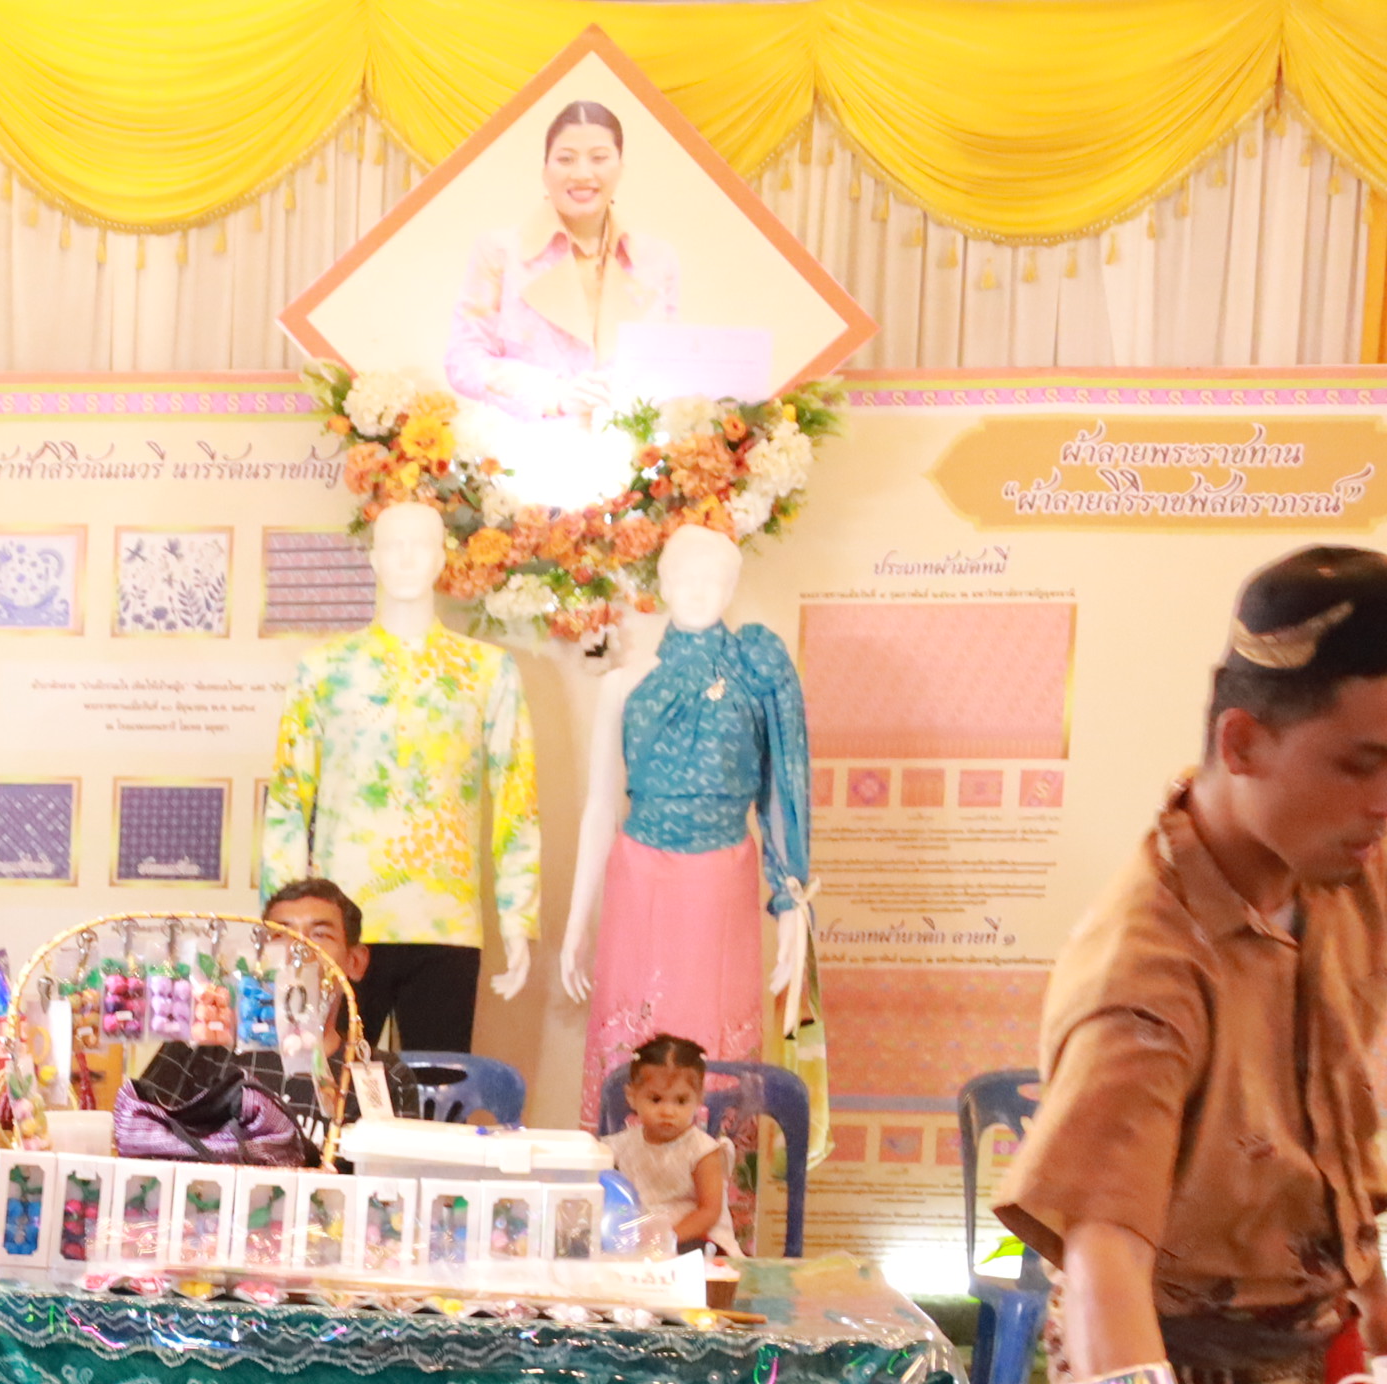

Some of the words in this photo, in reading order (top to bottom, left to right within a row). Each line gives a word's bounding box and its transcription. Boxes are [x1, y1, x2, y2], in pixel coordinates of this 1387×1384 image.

[172, 441, 345, 489] นารีรัตนราชกัญ
[1062, 420, 1303, 467] ผ้าลายพระราชทาน
